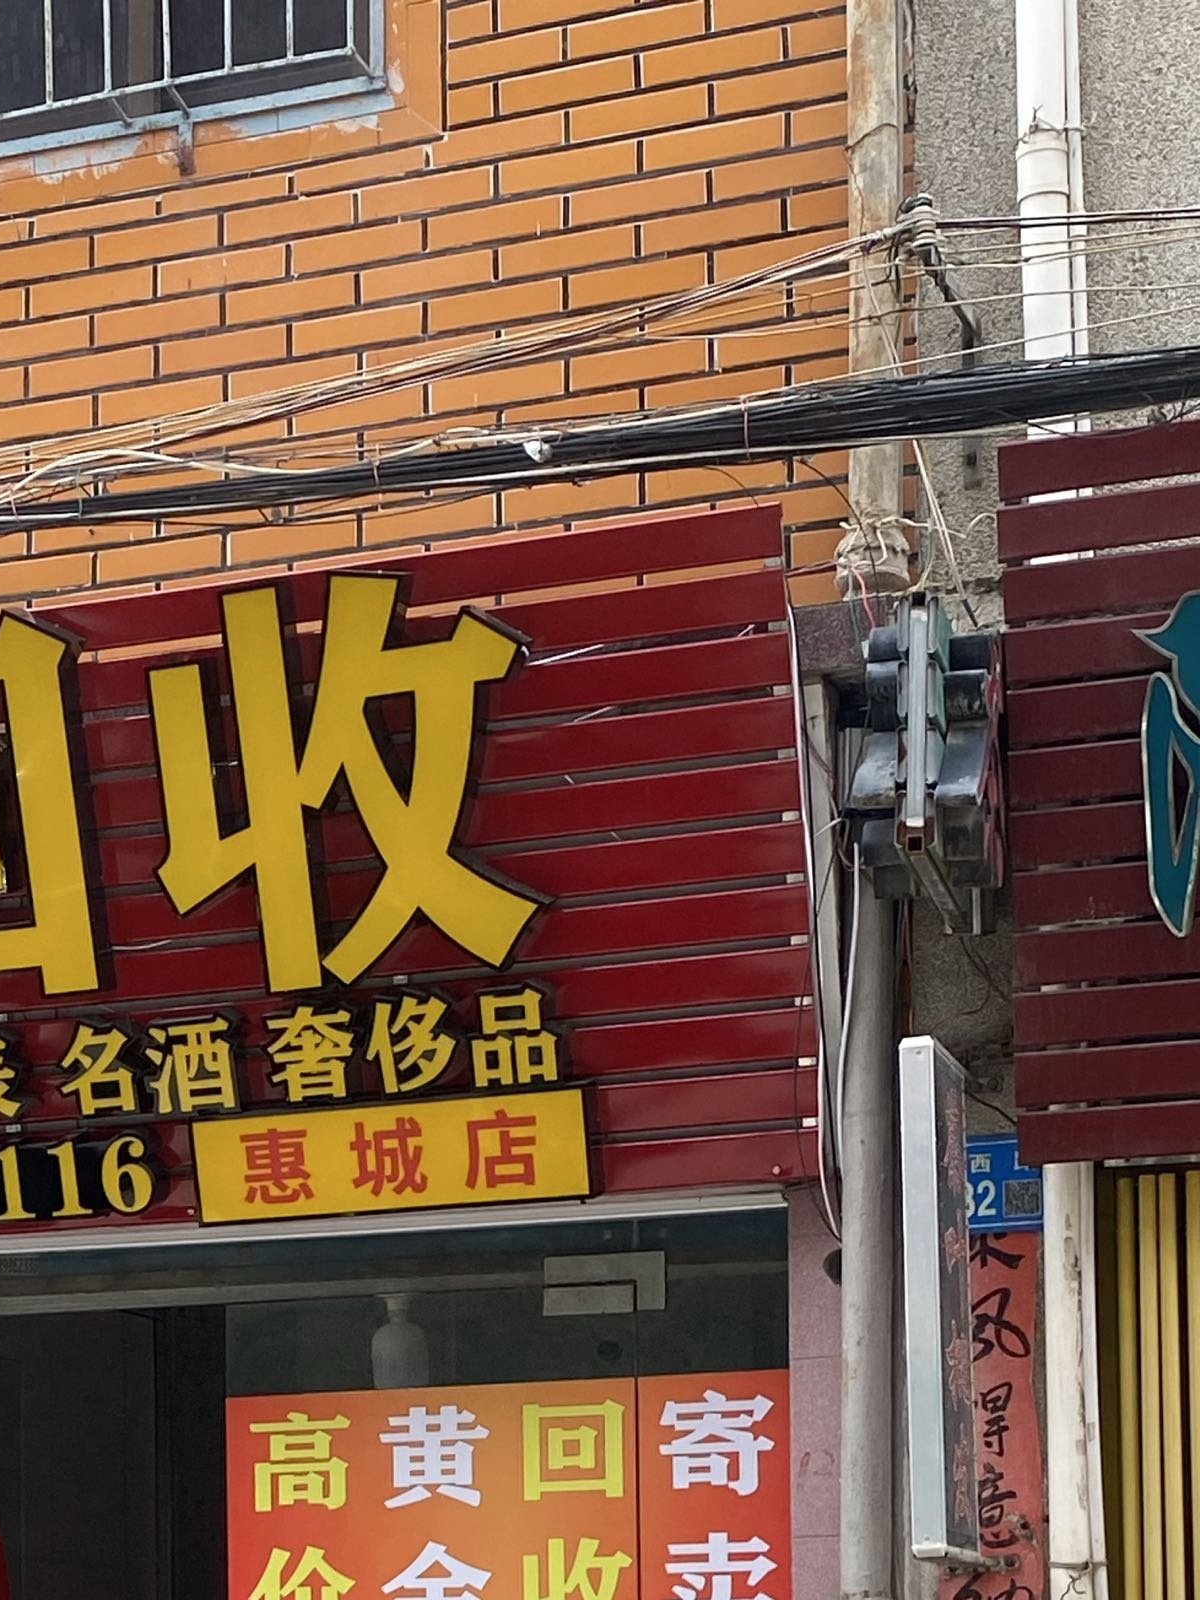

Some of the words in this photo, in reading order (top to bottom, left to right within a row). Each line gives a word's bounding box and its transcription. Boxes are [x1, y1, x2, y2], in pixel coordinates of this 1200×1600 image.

[61, 1017, 236, 1115] 名酒
[267, 989, 558, 1102] 奢侈品
[240, 1109, 538, 1205] 惠城店
